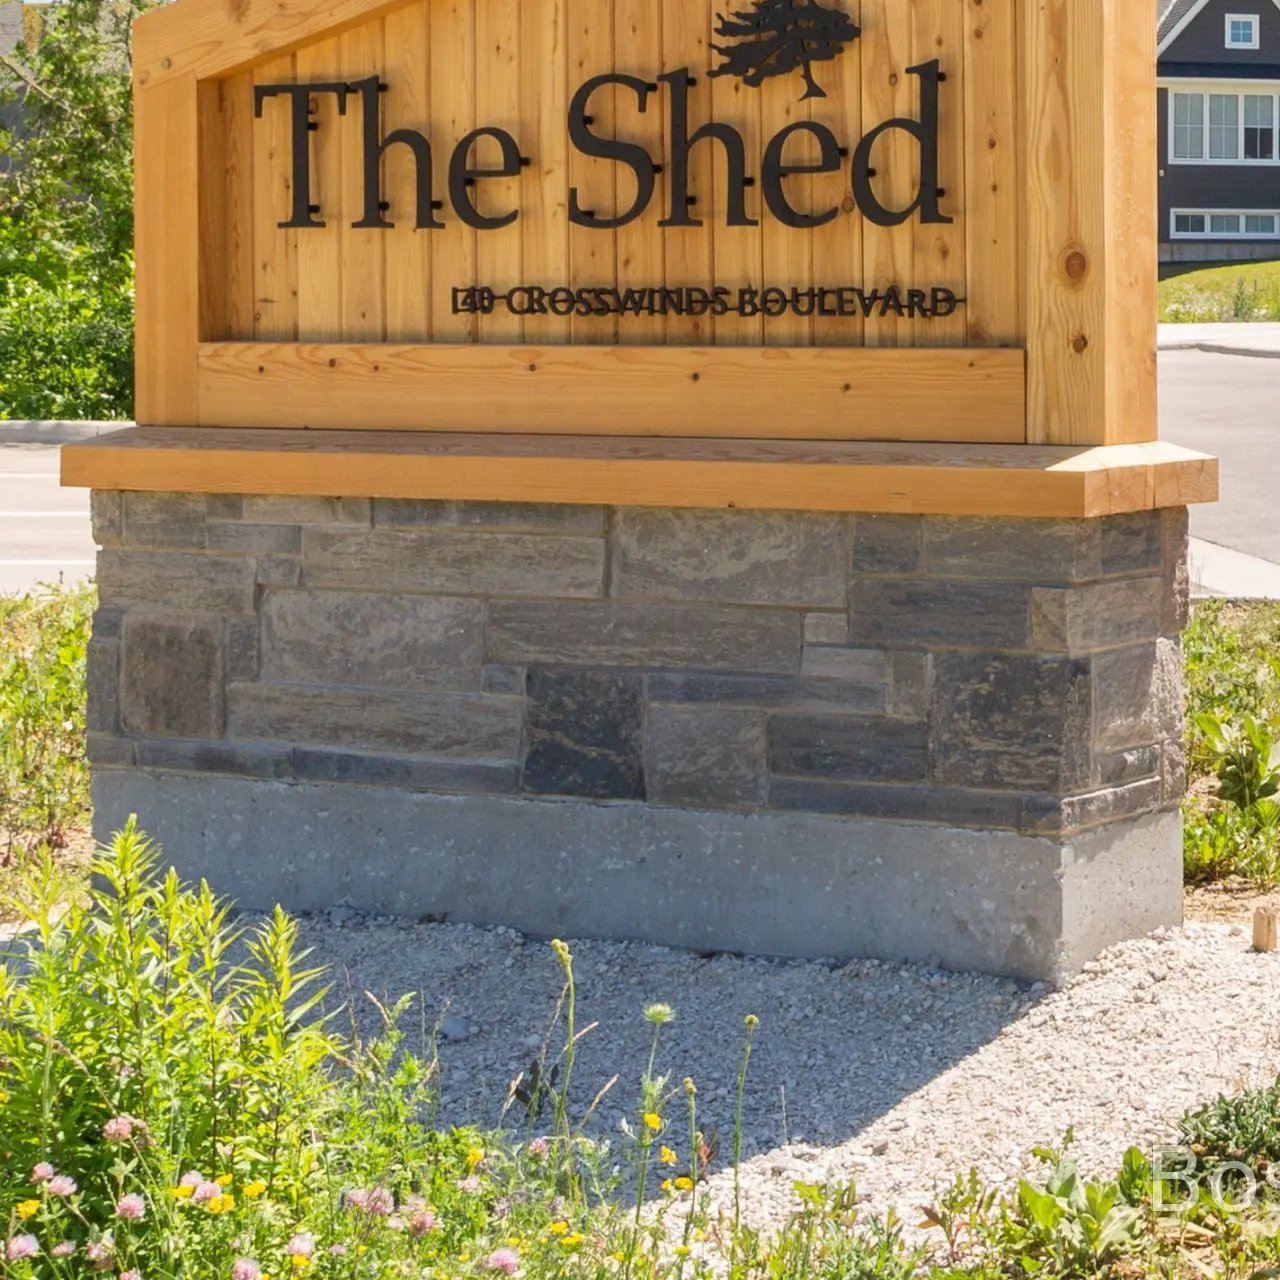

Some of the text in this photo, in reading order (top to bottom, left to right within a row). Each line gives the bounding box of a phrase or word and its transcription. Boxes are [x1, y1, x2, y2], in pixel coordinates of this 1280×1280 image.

[254, 59, 954, 230] The Shed
[506, 285, 730, 316] CROSSWINDS
[737, 285, 957, 319] BOULEVARD
